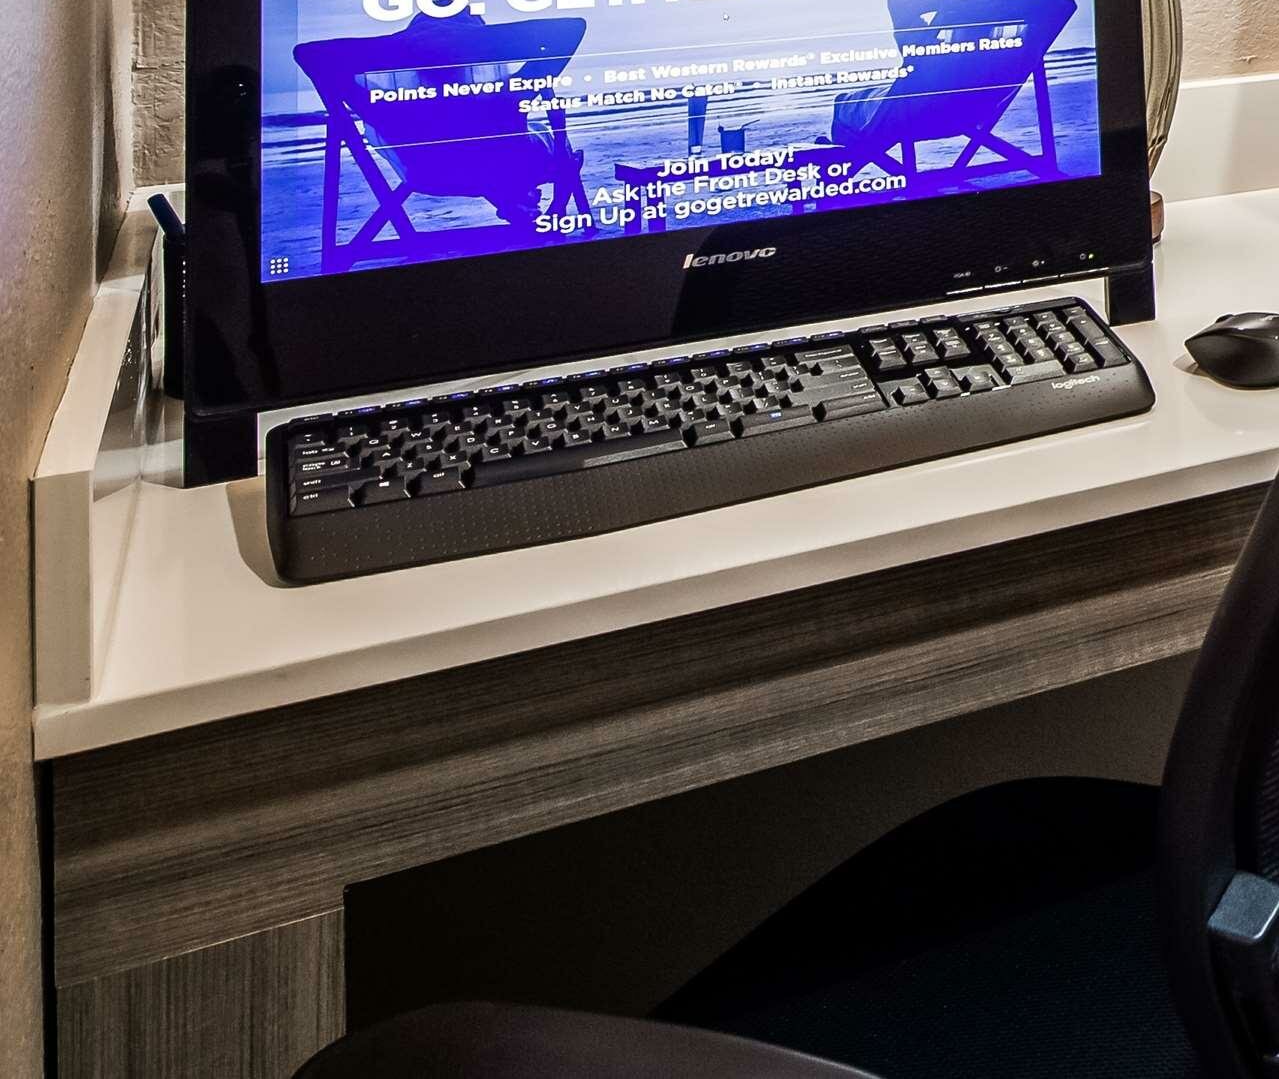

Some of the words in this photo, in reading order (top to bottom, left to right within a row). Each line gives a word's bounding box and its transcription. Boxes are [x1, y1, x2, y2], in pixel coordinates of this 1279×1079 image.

[369, 85, 438, 104] Points
[442, 80, 505, 99] Never
[508, 73, 573, 94] Expire
[604, 68, 646, 84] Best
[648, 61, 728, 81] Western
[820, 46, 898, 66] Exclusive
[901, 37, 976, 59] Members
[978, 34, 1024, 51] Rates
[518, 95, 582, 114] Status
[587, 90, 646, 108] Match
[650, 86, 677, 102] No
[771, 71, 834, 91] Instant
[592, 184, 640, 207] Ask
[645, 179, 686, 200] the
[694, 172, 760, 196] Front
[764, 164, 821, 187] Desk
[827, 160, 852, 178] or
[656, 158, 710, 178] Join
[719, 146, 796, 171] Today!
[535, 211, 593, 238] Sign
[599, 205, 637, 230] Up
[642, 202, 668, 221] at
[673, 172, 907, 221] gogetrewarded.com
[682, 245, 778, 270] lenovo
[1050, 374, 1101, 390] logitech
